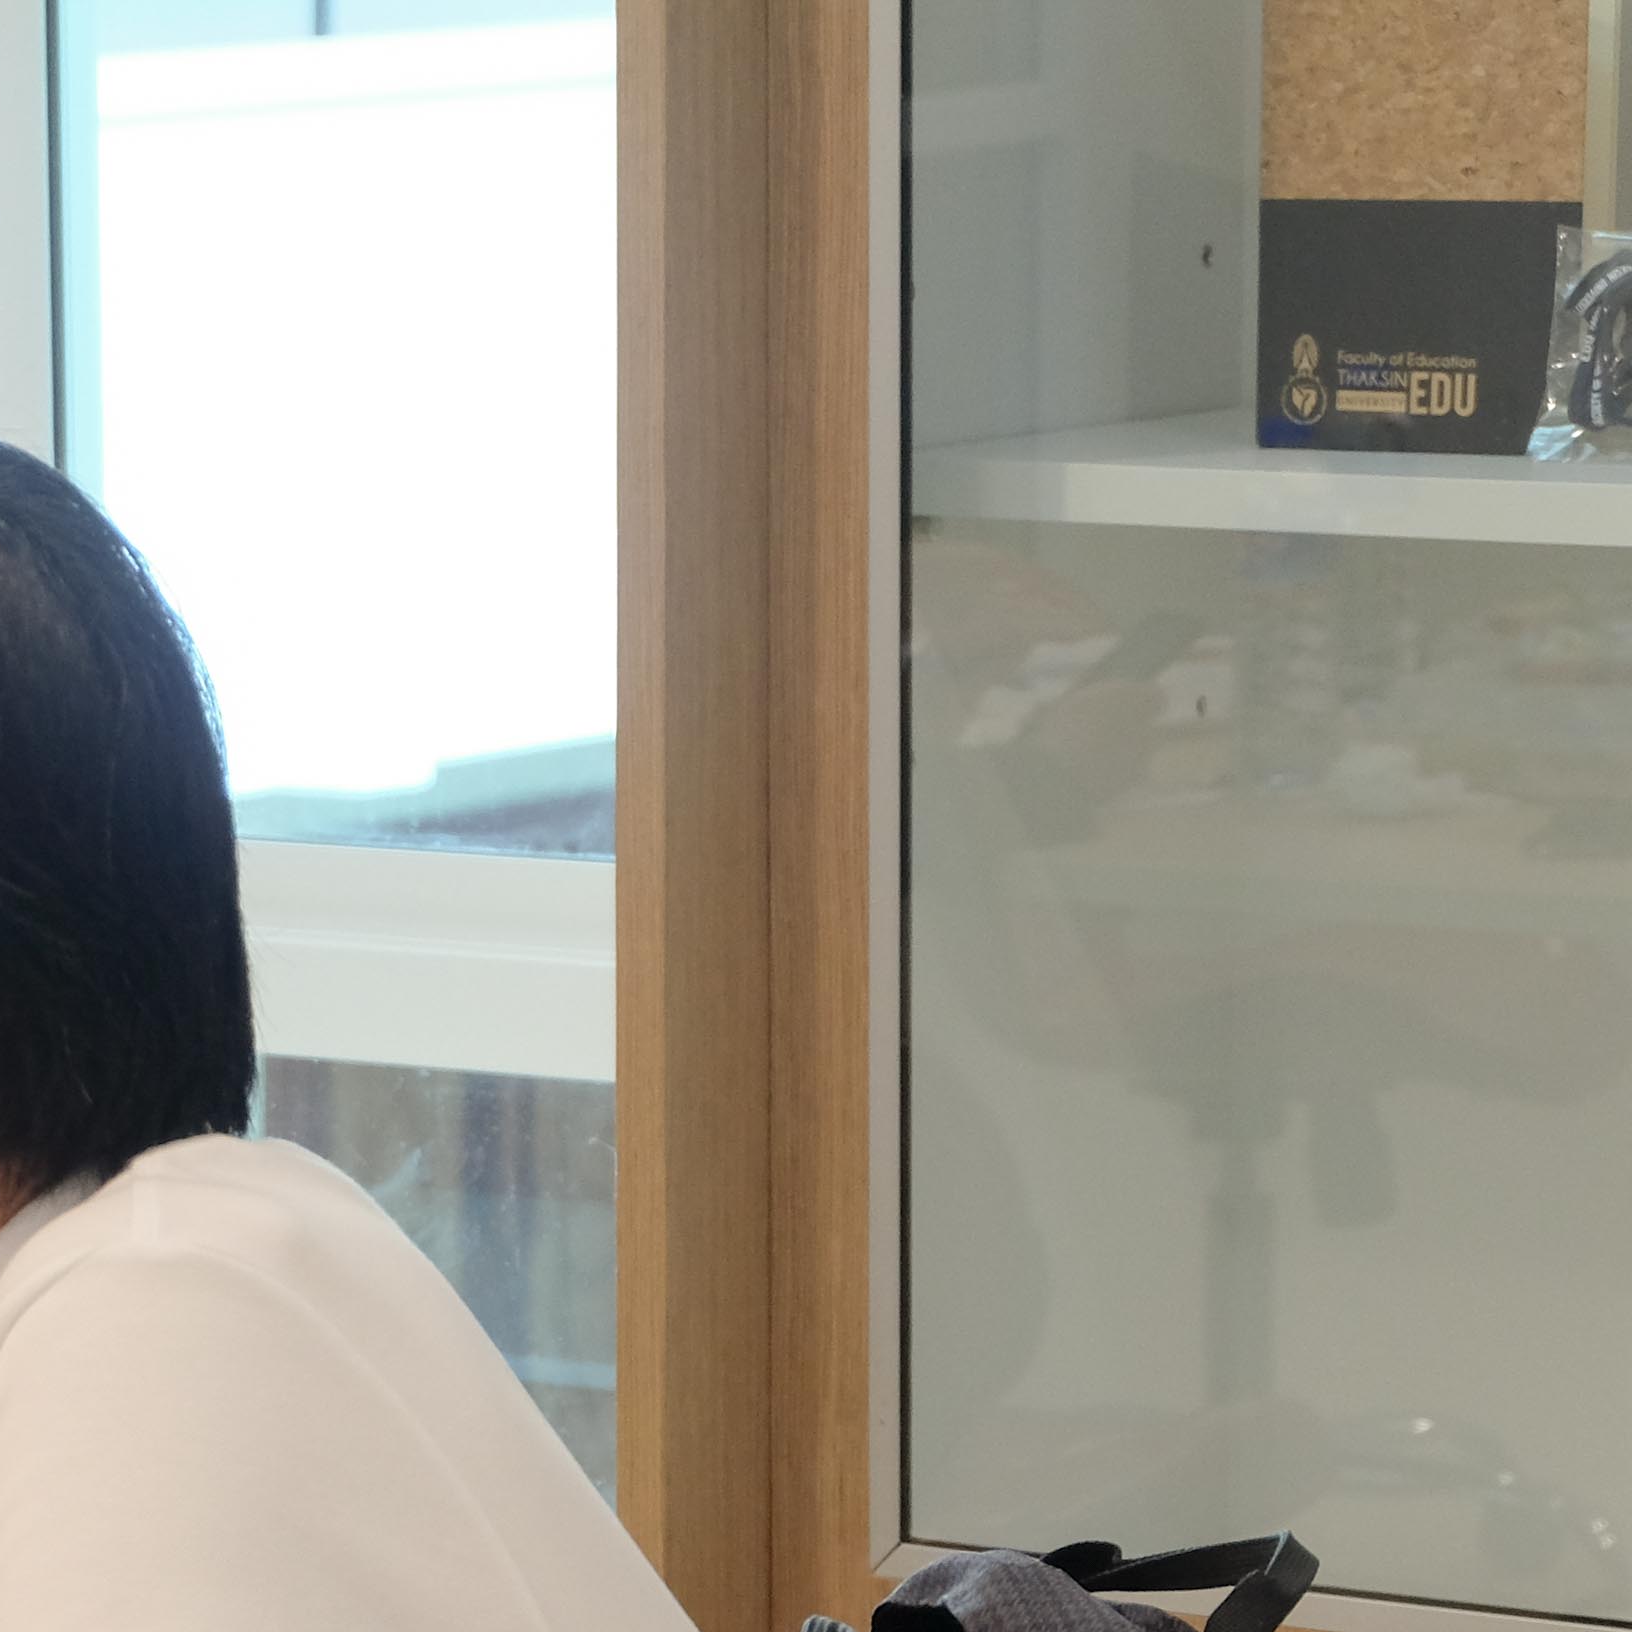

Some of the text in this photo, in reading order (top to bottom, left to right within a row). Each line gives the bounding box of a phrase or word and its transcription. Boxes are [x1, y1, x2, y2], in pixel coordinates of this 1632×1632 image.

[1337, 351, 1477, 369] Faculty of Education
[1337, 369, 1408, 388] THAKSIN
[1409, 371, 1477, 416] EDU
